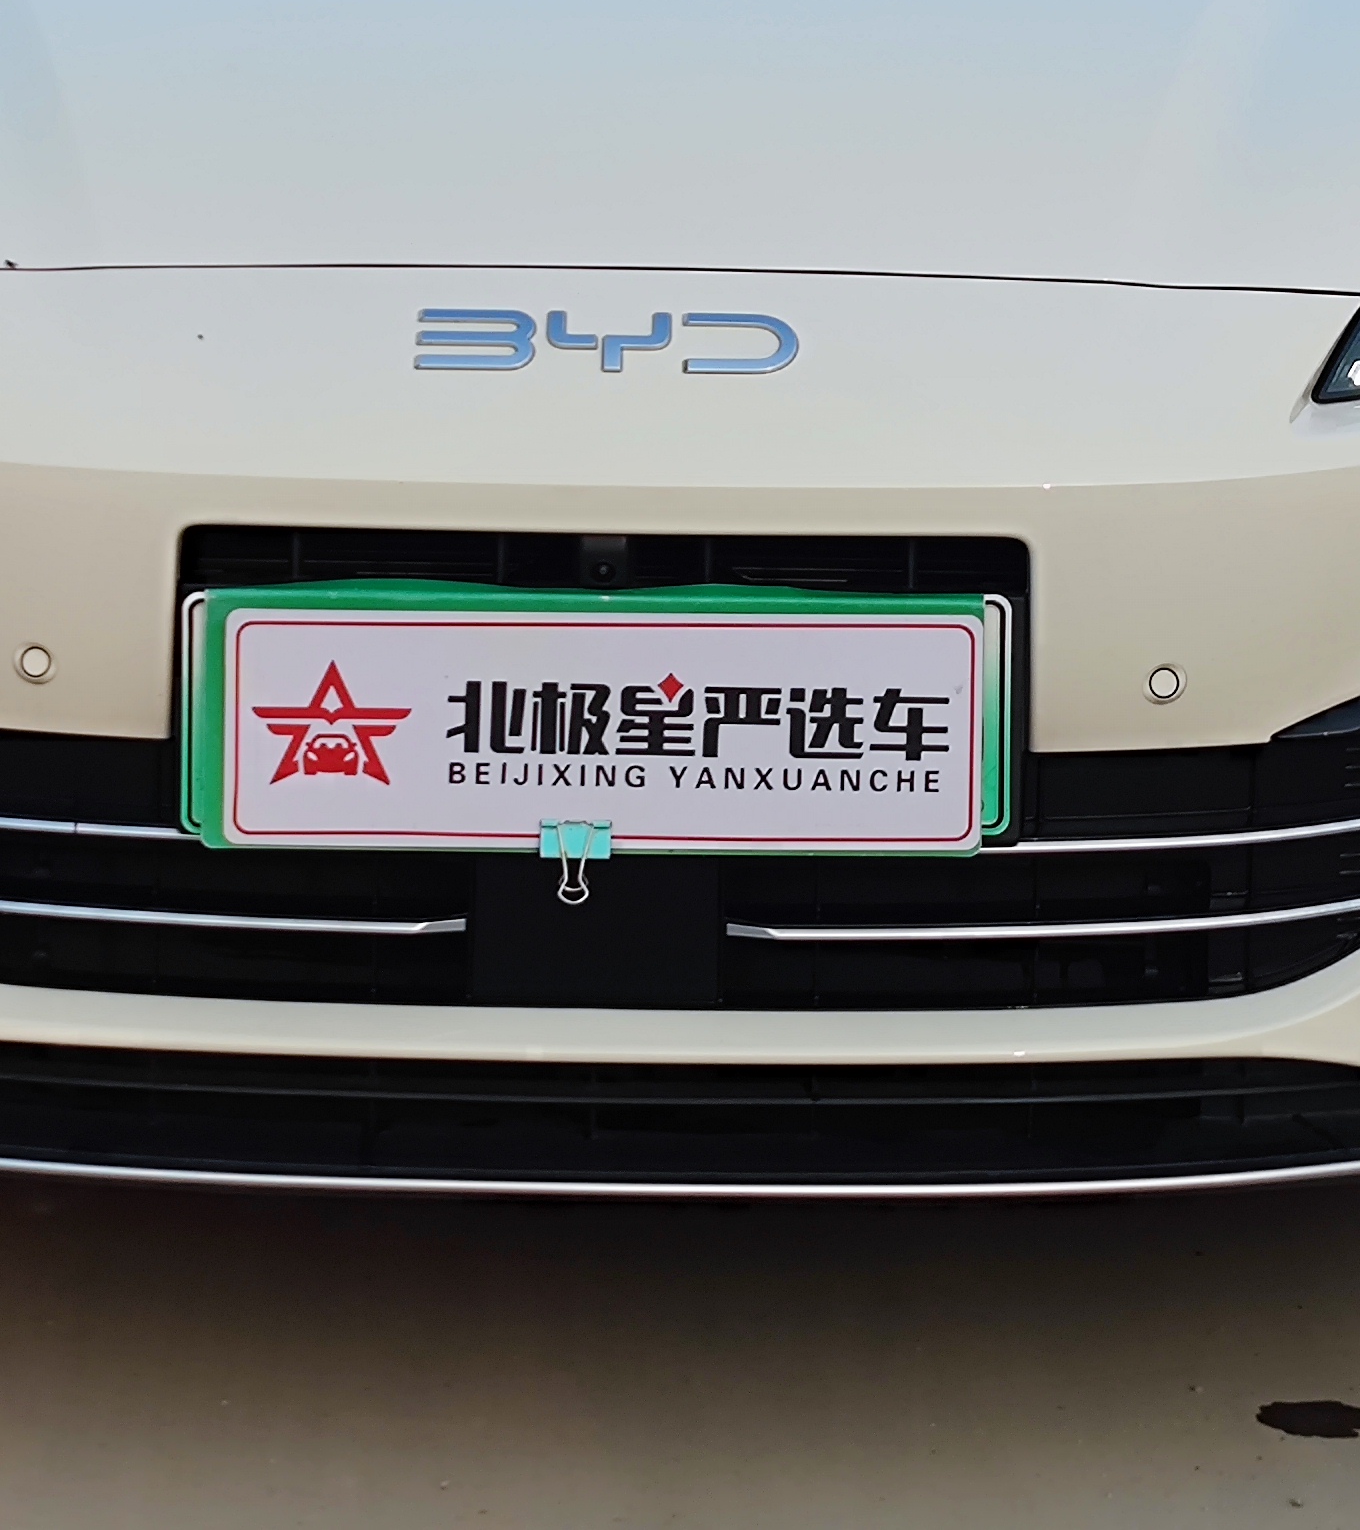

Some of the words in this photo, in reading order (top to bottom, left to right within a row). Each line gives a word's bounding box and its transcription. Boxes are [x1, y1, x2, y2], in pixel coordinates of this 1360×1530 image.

[414, 308, 800, 374] BYD
[445, 673, 950, 761] 北极星严选车
[448, 761, 647, 789] BEIJIXING
[669, 764, 941, 793] YANXUANCHE
